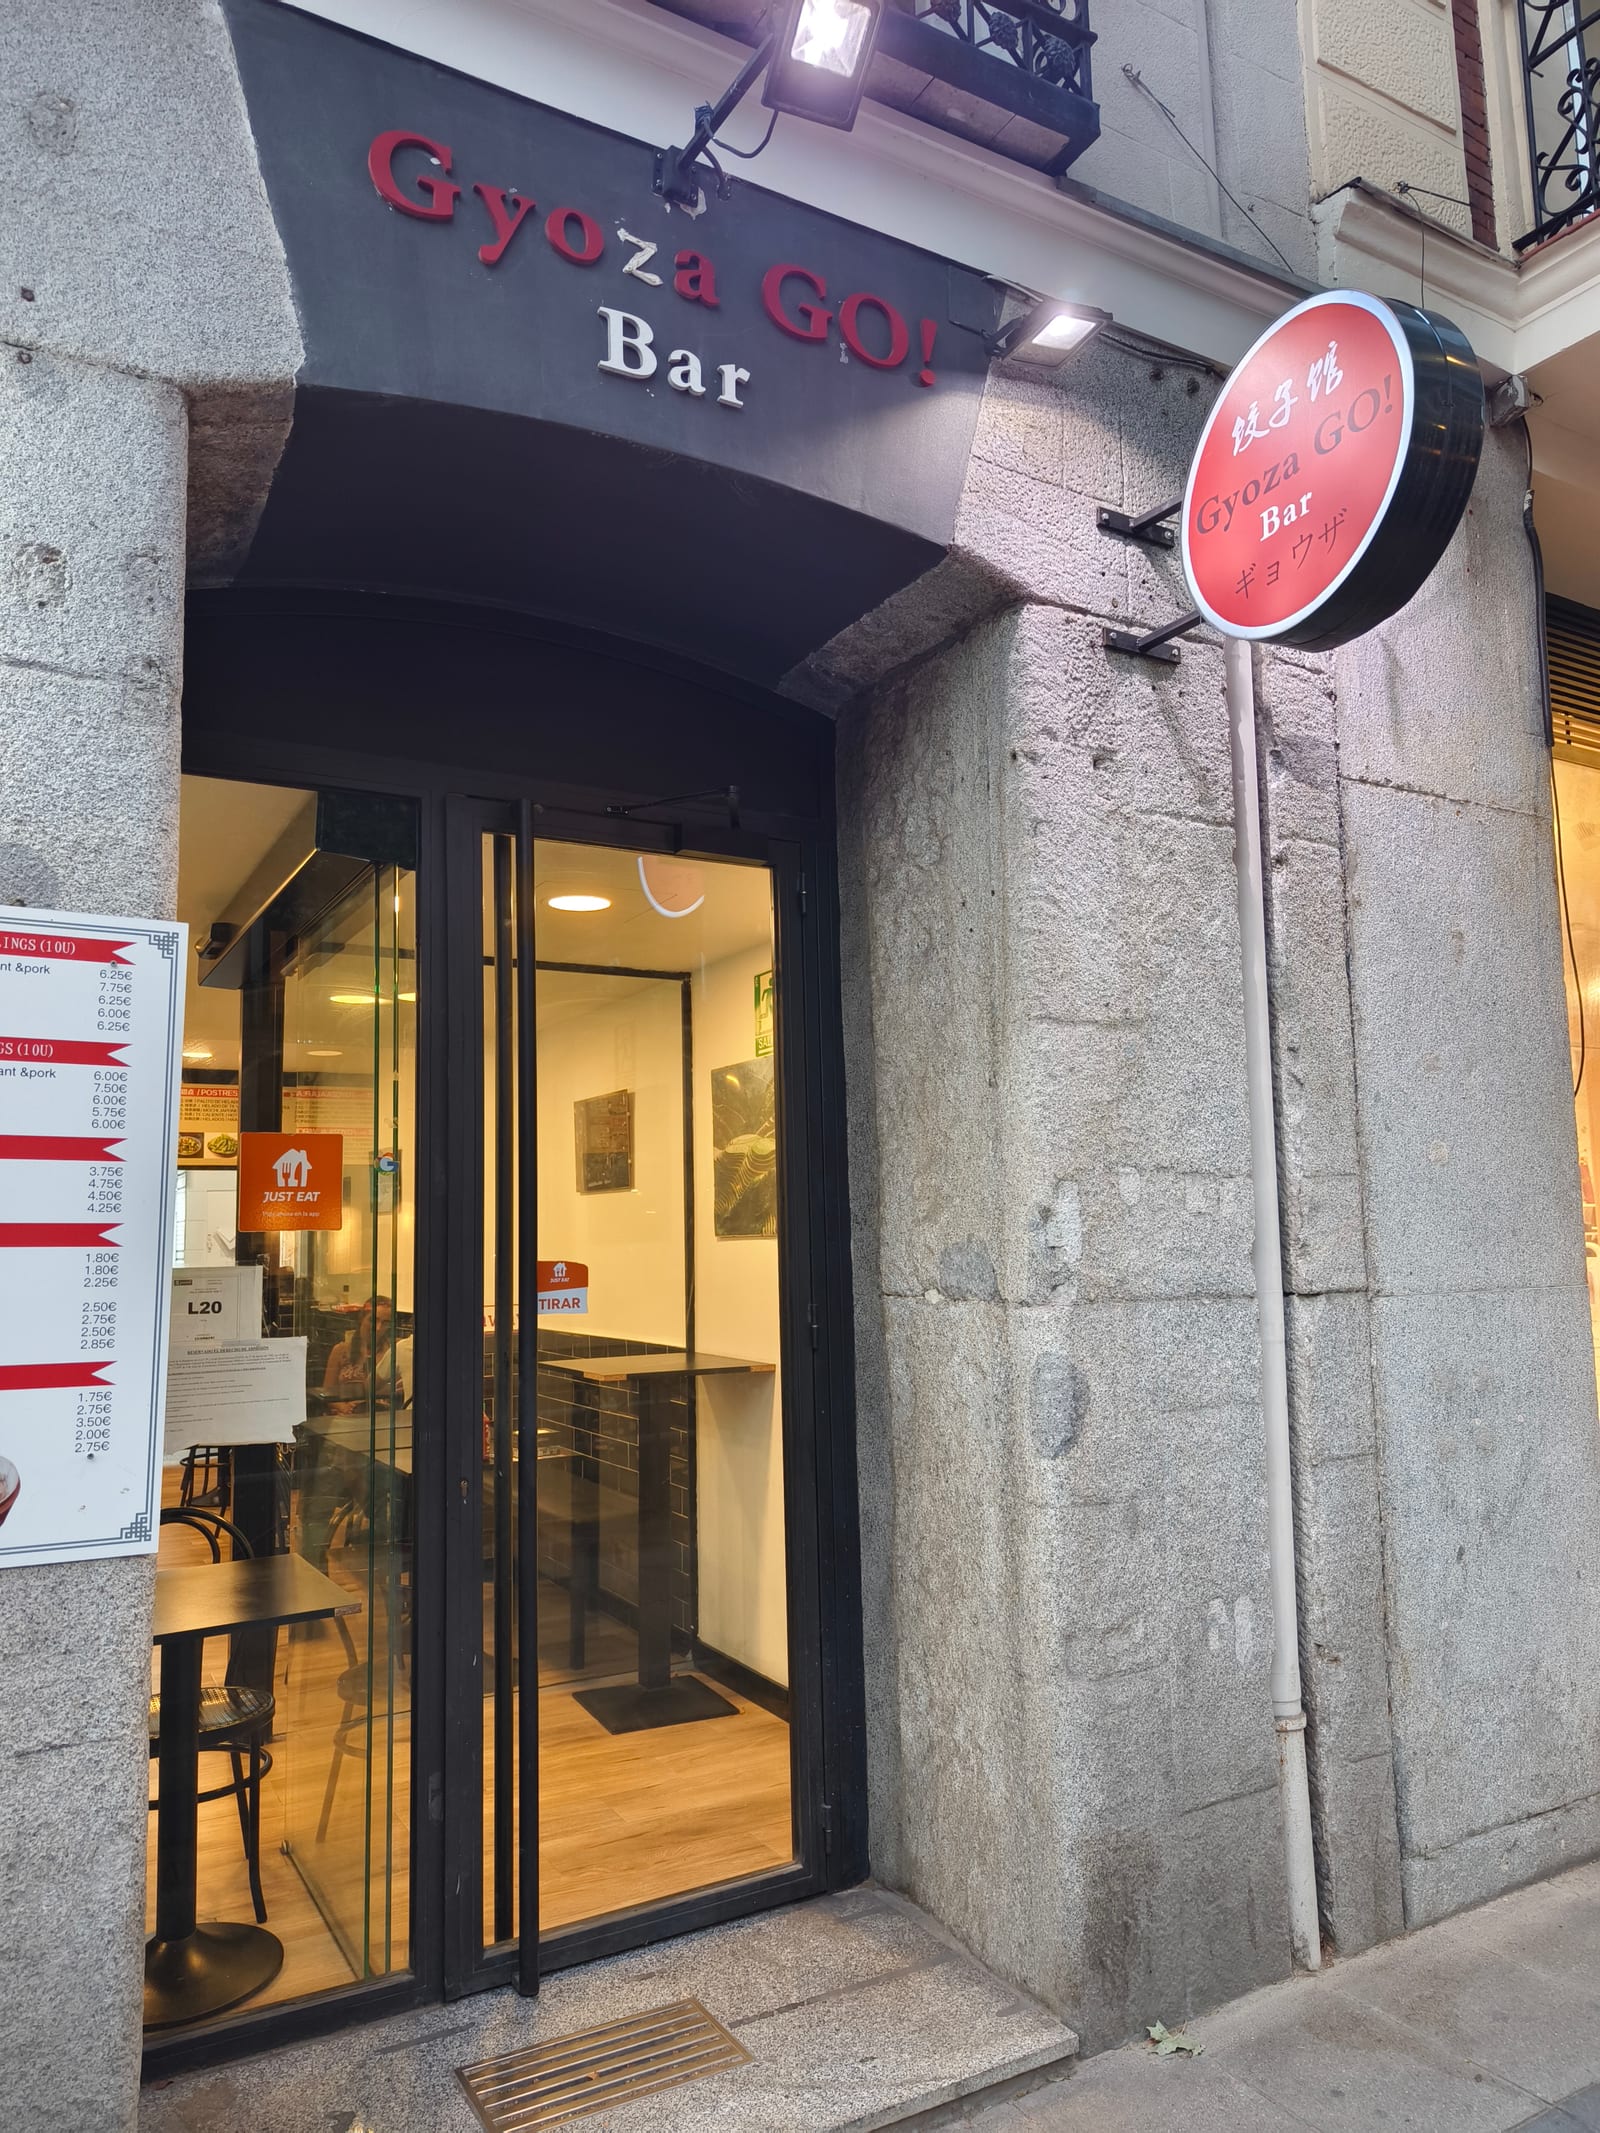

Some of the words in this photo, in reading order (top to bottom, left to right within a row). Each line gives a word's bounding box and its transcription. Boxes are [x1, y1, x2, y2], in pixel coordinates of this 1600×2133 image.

[367, 130, 720, 309] Gyoza
[762, 263, 938, 388] GO!
[597, 306, 752, 409] Bar
[1196, 452, 1300, 535] Gyoza
[1313, 374, 1393, 456] GO!
[1259, 492, 1313, 542] Bar
[100, 970, 132, 980] 6.25€
[100, 983, 132, 993] 7.75€
[99, 995, 131, 1006] 6.25€
[98, 1008, 131, 1019] 6.00€
[97, 1021, 130, 1032] 6.25€
[94, 1071, 128, 1081] 6.00€
[94, 1083, 127, 1093] 7.50€
[93, 1095, 127, 1105] 6.00€
[92, 1107, 126, 1117] 5.75€
[92, 1119, 125, 1129] 6.00€
[90, 1167, 123, 1176] 3.75€
[89, 1179, 123, 1188] 4.75€
[88, 1191, 122, 1200] 4.50€
[262, 1191, 294, 1204] JUST
[296, 1191, 321, 1202] EAT
[87, 1203, 122, 1213] 4.25€
[86, 1253, 119, 1262] 1.80€
[85, 1265, 118, 1275] 1.80€
[84, 1278, 118, 1287] 2.25€
[83, 1302, 117, 1312] 2.50€
[188, 1301, 223, 1315] L20
[538, 1298, 581, 1310] TIRAR
[82, 1314, 116, 1324] 2.75€
[81, 1327, 115, 1336] 2.50€
[81, 1339, 115, 1349] 2.85€
[78, 1392, 112, 1402] 1.75€
[77, 1404, 111, 1415] 2.75€
[76, 1416, 111, 1427] 3.50€
[76, 1429, 110, 1440] 2.00€
[75, 1441, 110, 1453] 2.75€
